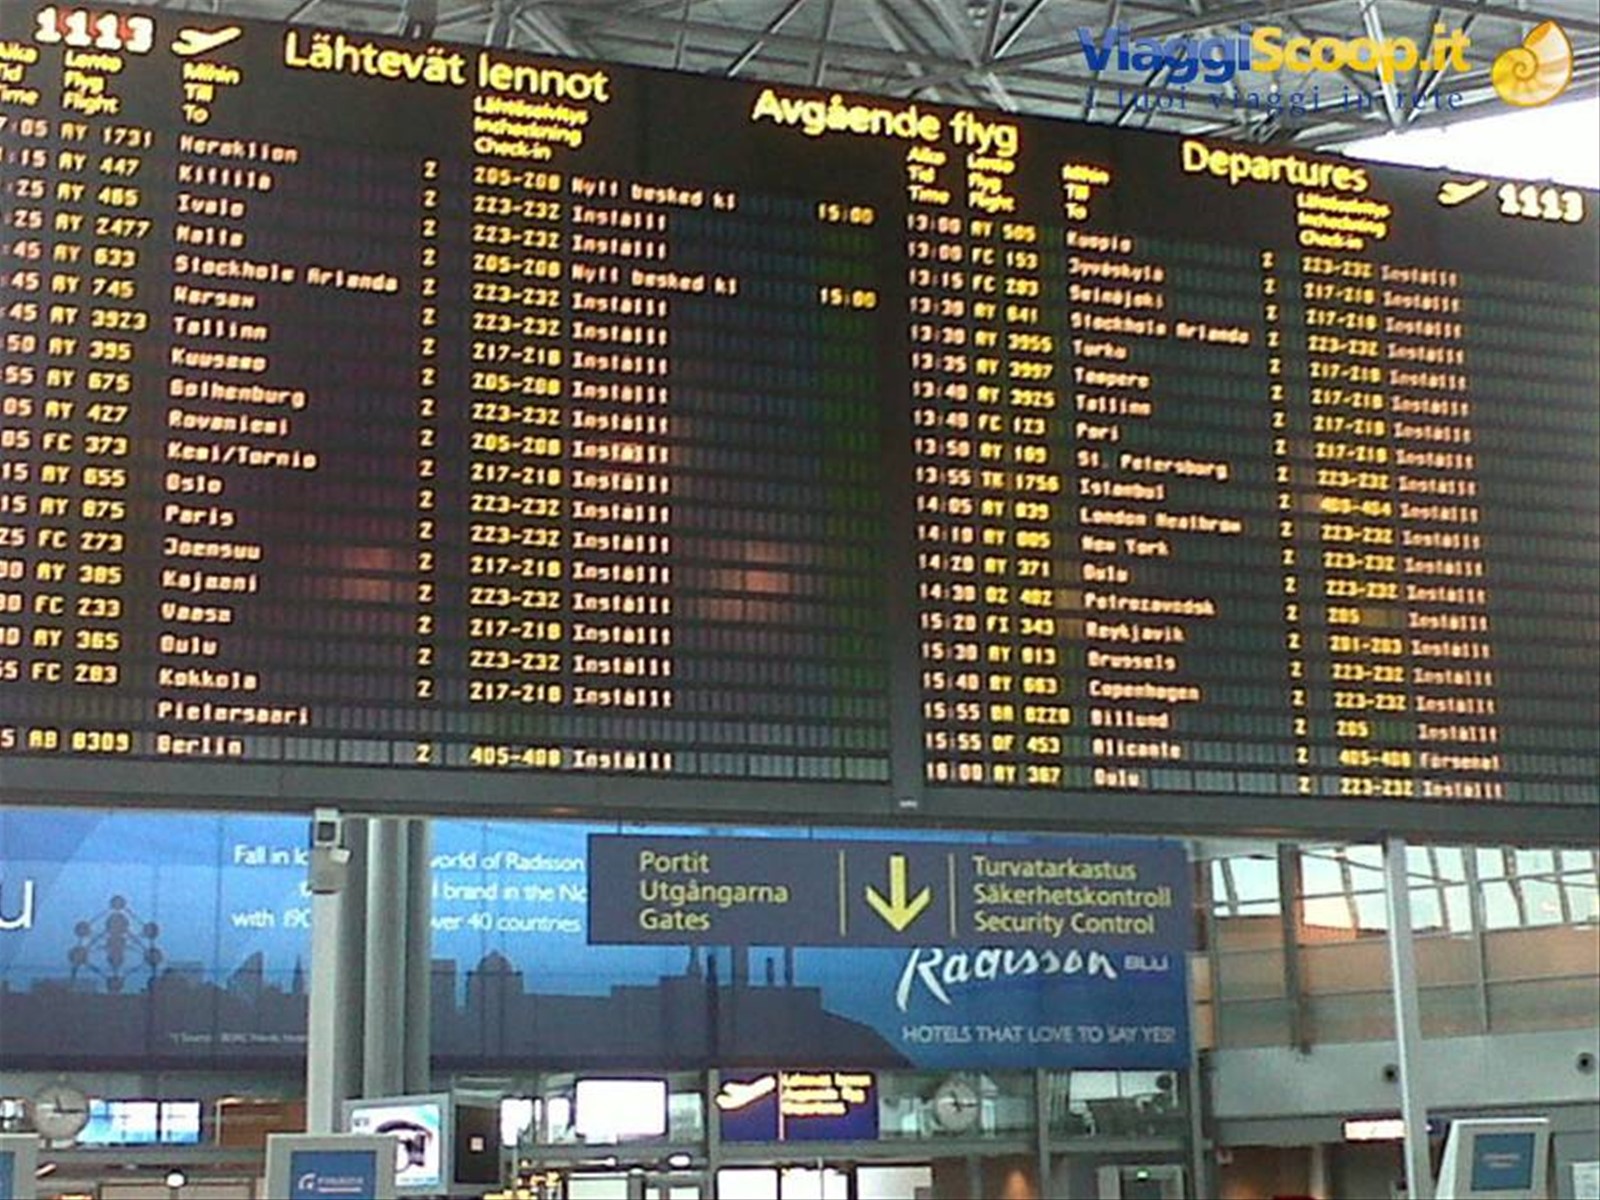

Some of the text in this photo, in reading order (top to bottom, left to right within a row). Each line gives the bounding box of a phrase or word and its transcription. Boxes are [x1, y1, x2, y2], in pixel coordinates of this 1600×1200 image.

[35, 7, 153, 53] 1113
[285, 31, 609, 103] Lähtevät lennot
[182, 103, 209, 123] To
[751, 89, 1018, 158] Avgående flyg
[103, 126, 152, 148] 1731
[99, 156, 140, 176] 447
[1182, 140, 1368, 191] Departures
[1499, 186, 1583, 222] 1113
[96, 217, 150, 238] 2477
[94, 247, 136, 268] 633
[93, 278, 134, 299] 745
[86, 404, 128, 423] 427
[43, 432, 72, 452] FC
[85, 435, 128, 455] 373
[165, 504, 234, 527] Paris
[38, 529, 67, 549] FC
[80, 531, 123, 552] 273
[34, 594, 64, 615] FC
[77, 597, 120, 618] 233
[31, 662, 61, 682] FC
[232, 843, 267, 865] Fall
[481, 851, 501, 870] of
[504, 851, 585, 871] Radisson
[638, 850, 710, 874] Portit
[971, 854, 1138, 881] Turvatarkastus
[442, 880, 498, 901] brand
[639, 878, 789, 908] Utgångarna
[972, 882, 1172, 908] Säkerhetskontroll
[229, 908, 276, 929] with
[465, 911, 494, 931] 40
[497, 914, 583, 934] countries
[638, 907, 711, 932] Gates
[973, 909, 1155, 939] Security Control
[902, 1025, 973, 1044] HOTELS
[975, 1025, 1024, 1044] THAT
[1027, 1025, 1073, 1044] LOVE
[1077, 1025, 1103, 1044] TO
[1107, 1025, 1139, 1044] SAY
